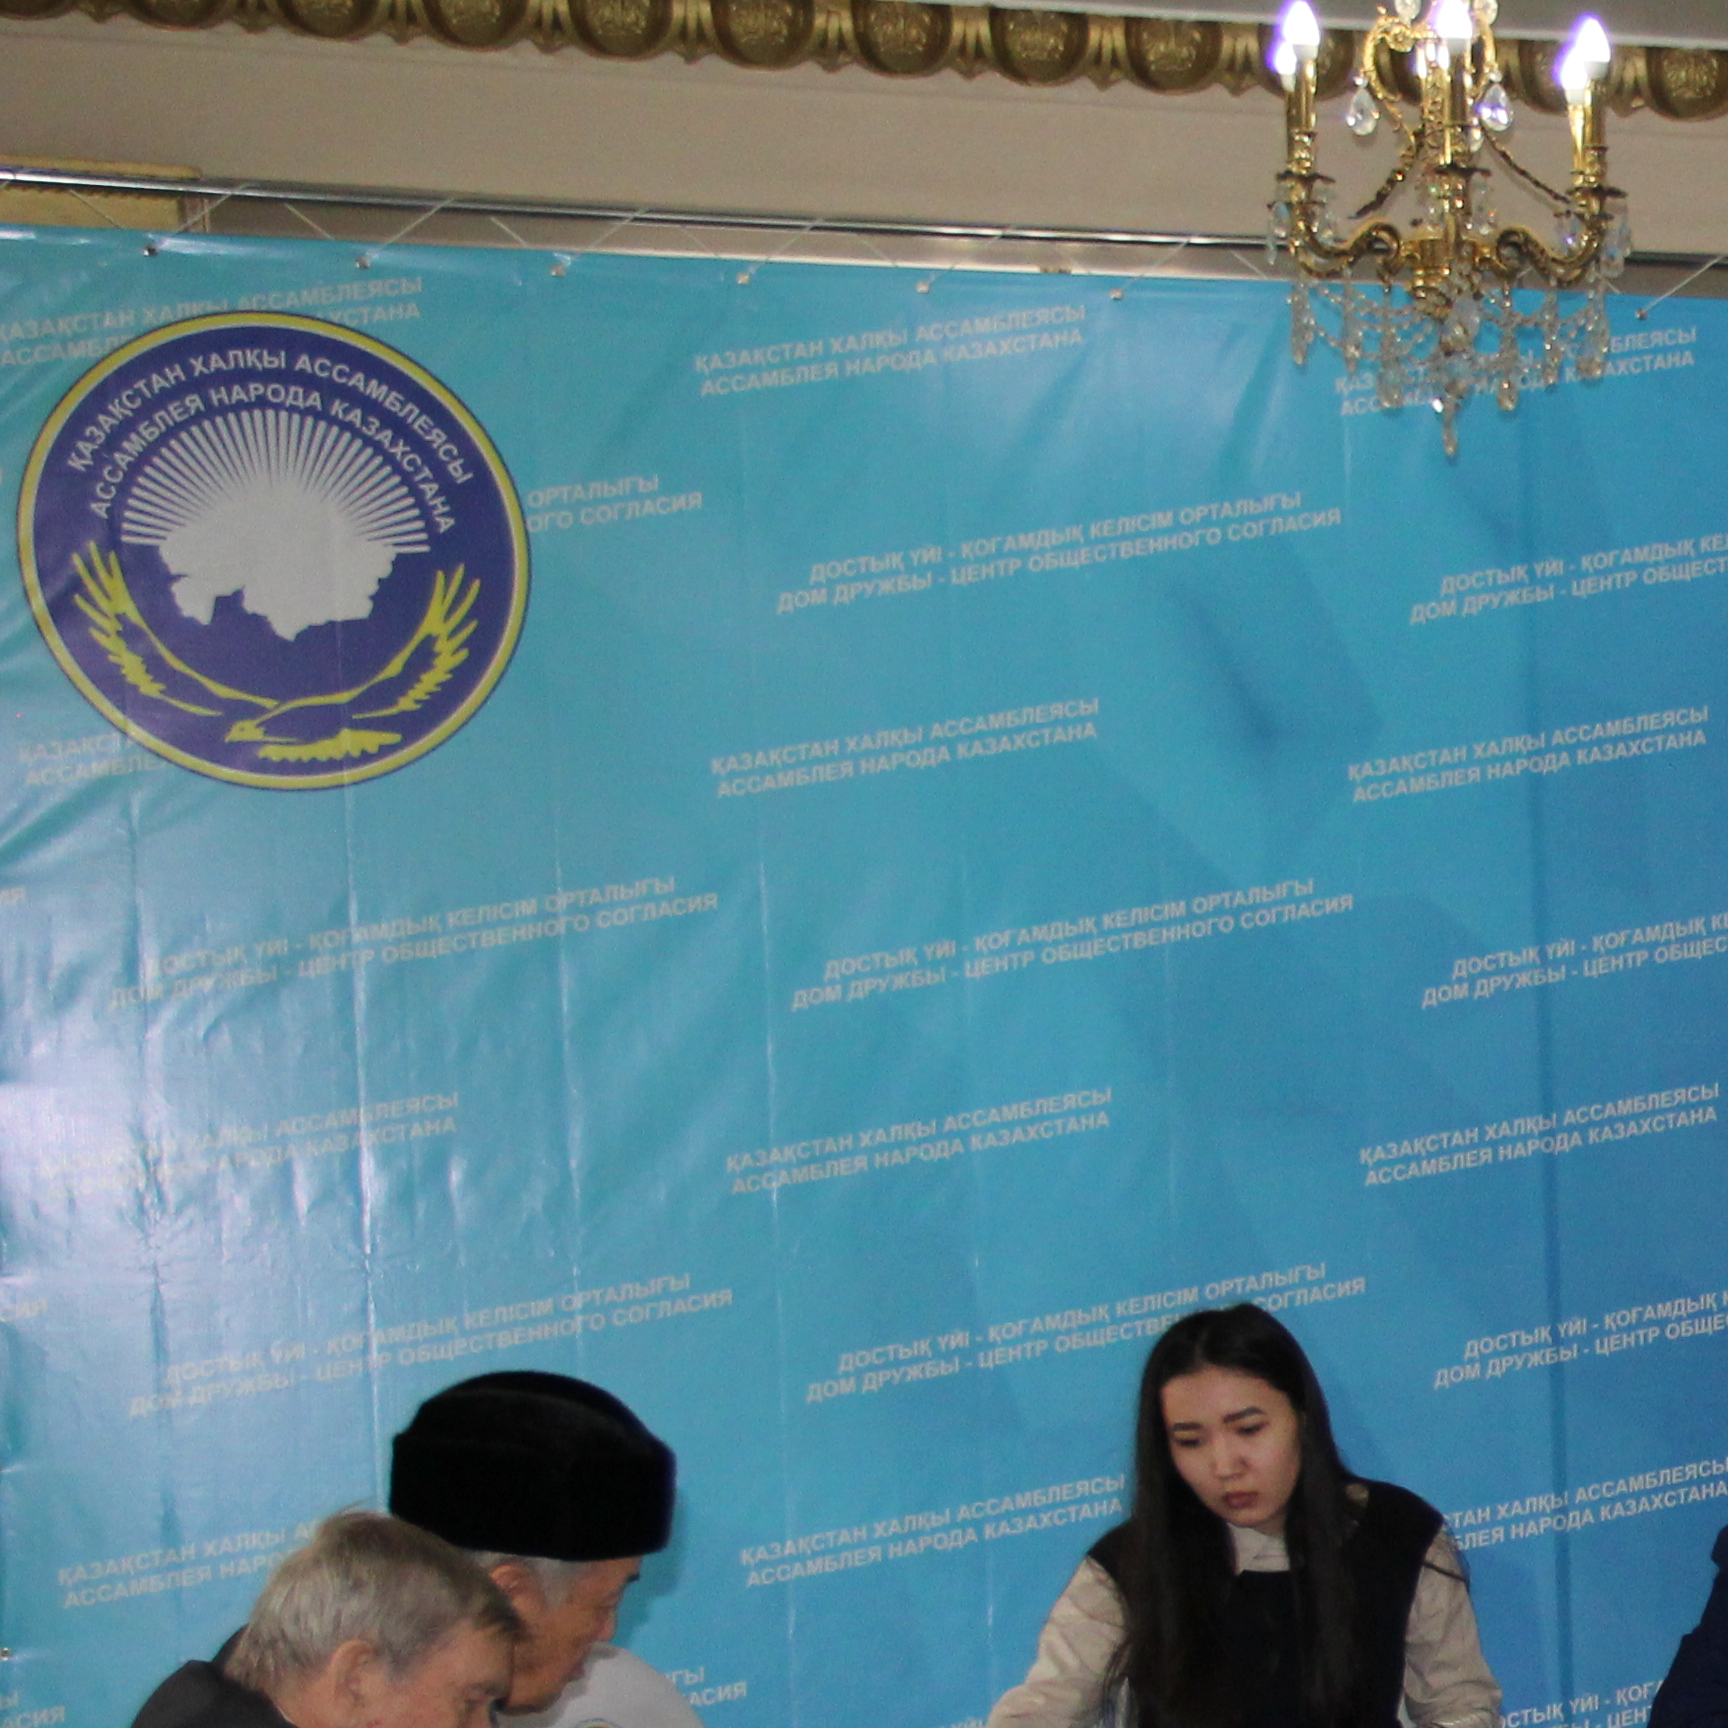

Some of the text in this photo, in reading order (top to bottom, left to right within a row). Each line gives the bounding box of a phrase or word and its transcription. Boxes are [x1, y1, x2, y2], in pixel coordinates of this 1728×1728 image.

[67, 349, 474, 484] ҚАЗАҚСТАН ХАЛҚЫ АССАМБЛЕЯСЫ
[90, 382, 456, 534] АССАМБЛЕЯ НАРОДА КАЗАХСТАНА
[1347, 706, 1709, 783] ҚАЗАҚСТАН ХАЛҚЫ АССАМБЛЕЯСЫ
[1353, 729, 1707, 802] АССАМБЛЕЯ НАРОДА КАЗАХСТАНА
[1421, 982, 1469, 1009] ДОМ
[1473, 965, 1566, 999] ДРУЖБЫ
[1583, 950, 1648, 978] ЦЕНТР
[1451, 947, 1539, 980] ДОСТЫҚ
[1360, 1082, 1719, 1166] ҚАЗАҚСТАН ХАЛҚЫ АССАМБЛЕЯСЫ
[1365, 1106, 1717, 1186] АССАМБЛЕЯ НАРОДА КАЗАХСТАНА
[1433, 1362, 1481, 1390] ДОМ
[1485, 1343, 1578, 1379] ДРУЖБЫ
[1595, 1327, 1660, 1355] ЦЕНТР
[1463, 1326, 1551, 1361] ДОСТЫҚ
